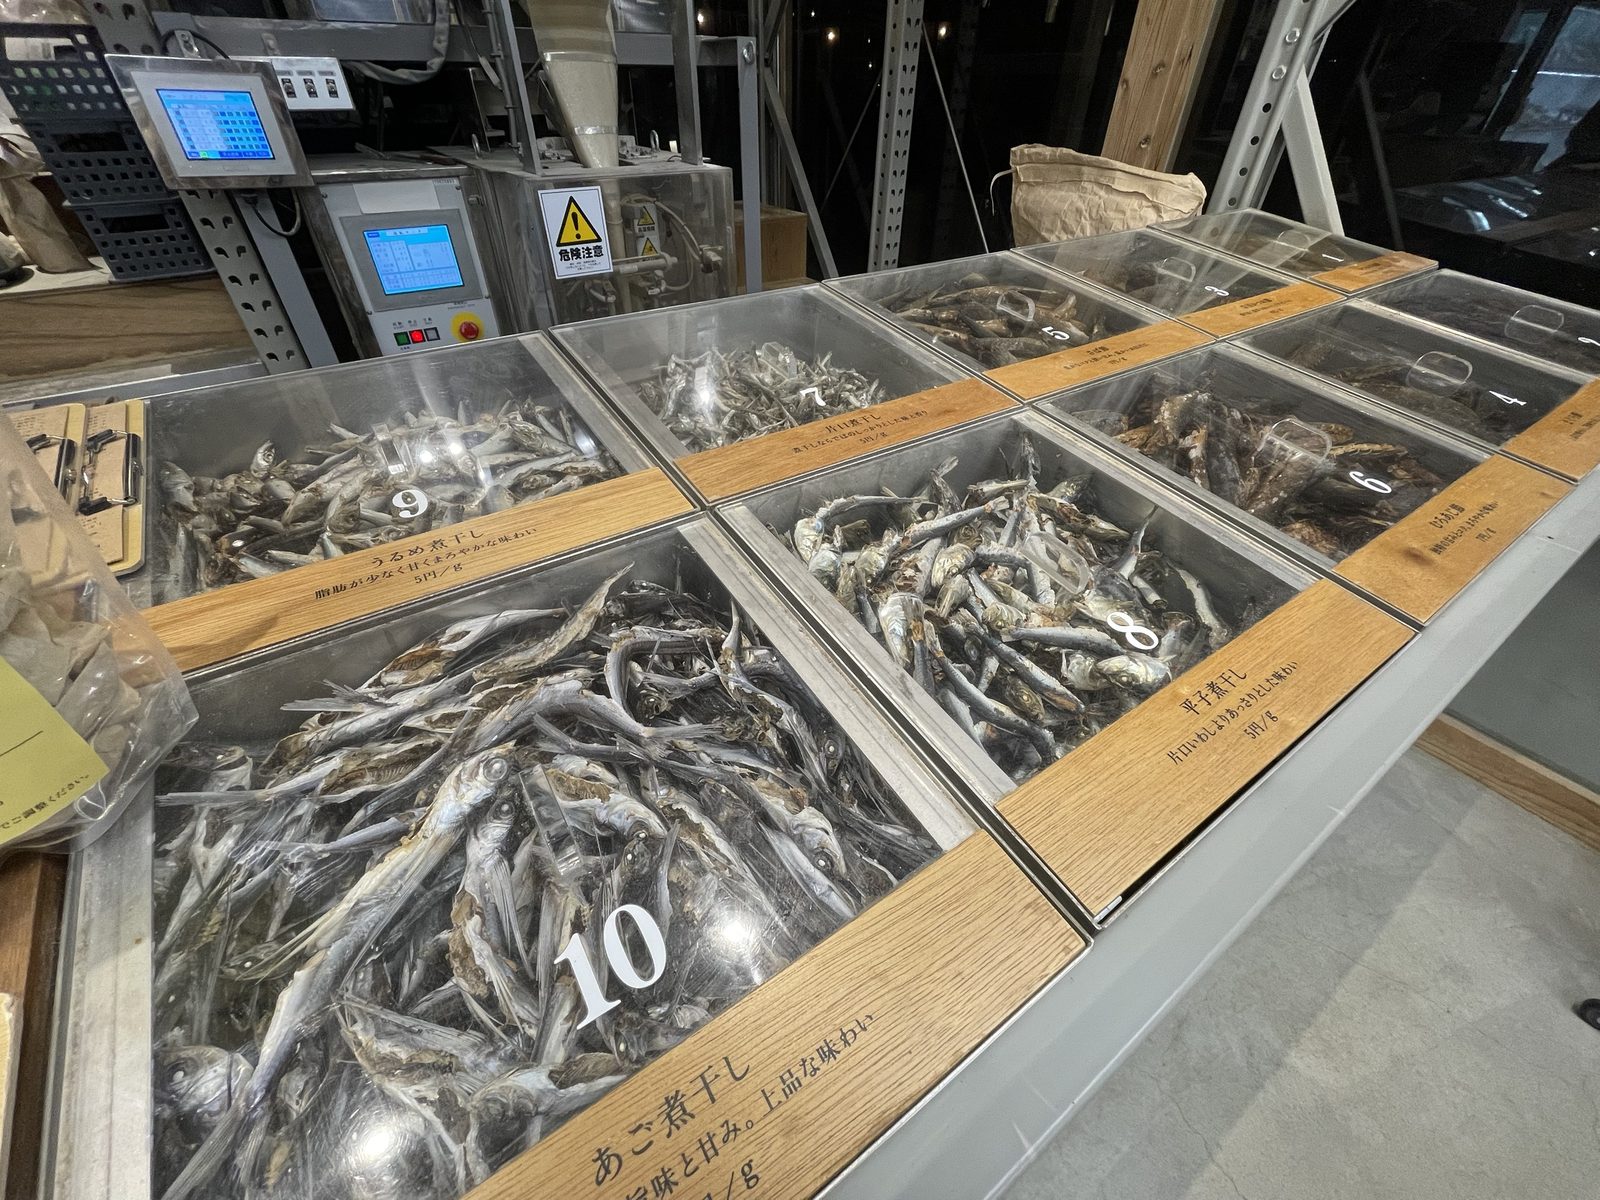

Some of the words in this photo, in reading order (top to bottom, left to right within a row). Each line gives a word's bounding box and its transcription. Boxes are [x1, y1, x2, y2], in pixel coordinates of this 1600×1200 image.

[558, 244, 604, 261] 危険注意
[1321, 253, 1345, 262] 1
[1204, 285, 1230, 297] 3
[1041, 326, 1070, 341] 5
[799, 386, 827, 407] 7
[1488, 390, 1527, 406] 4
[825, 414, 882, 434] 片口煮干し
[1349, 470, 1392, 494] 6
[392, 489, 428, 519] 9
[314, 527, 538, 600] 脂肪が少なく甘くまろやかな味わい
[371, 529, 485, 568] うるめ煮干し
[413, 563, 464, 584] 5円/g
[1106, 611, 1159, 650] 8
[1178, 667, 1248, 717] 平子煮干し
[1165, 660, 1299, 766] 片口いわしよりあっさりとした味わい
[1242, 710, 1280, 740] 5円/g
[553, 903, 667, 1030] 10
[594, 1055, 751, 1187] あご煮干し
[702, 1159, 759, 1200] /g
